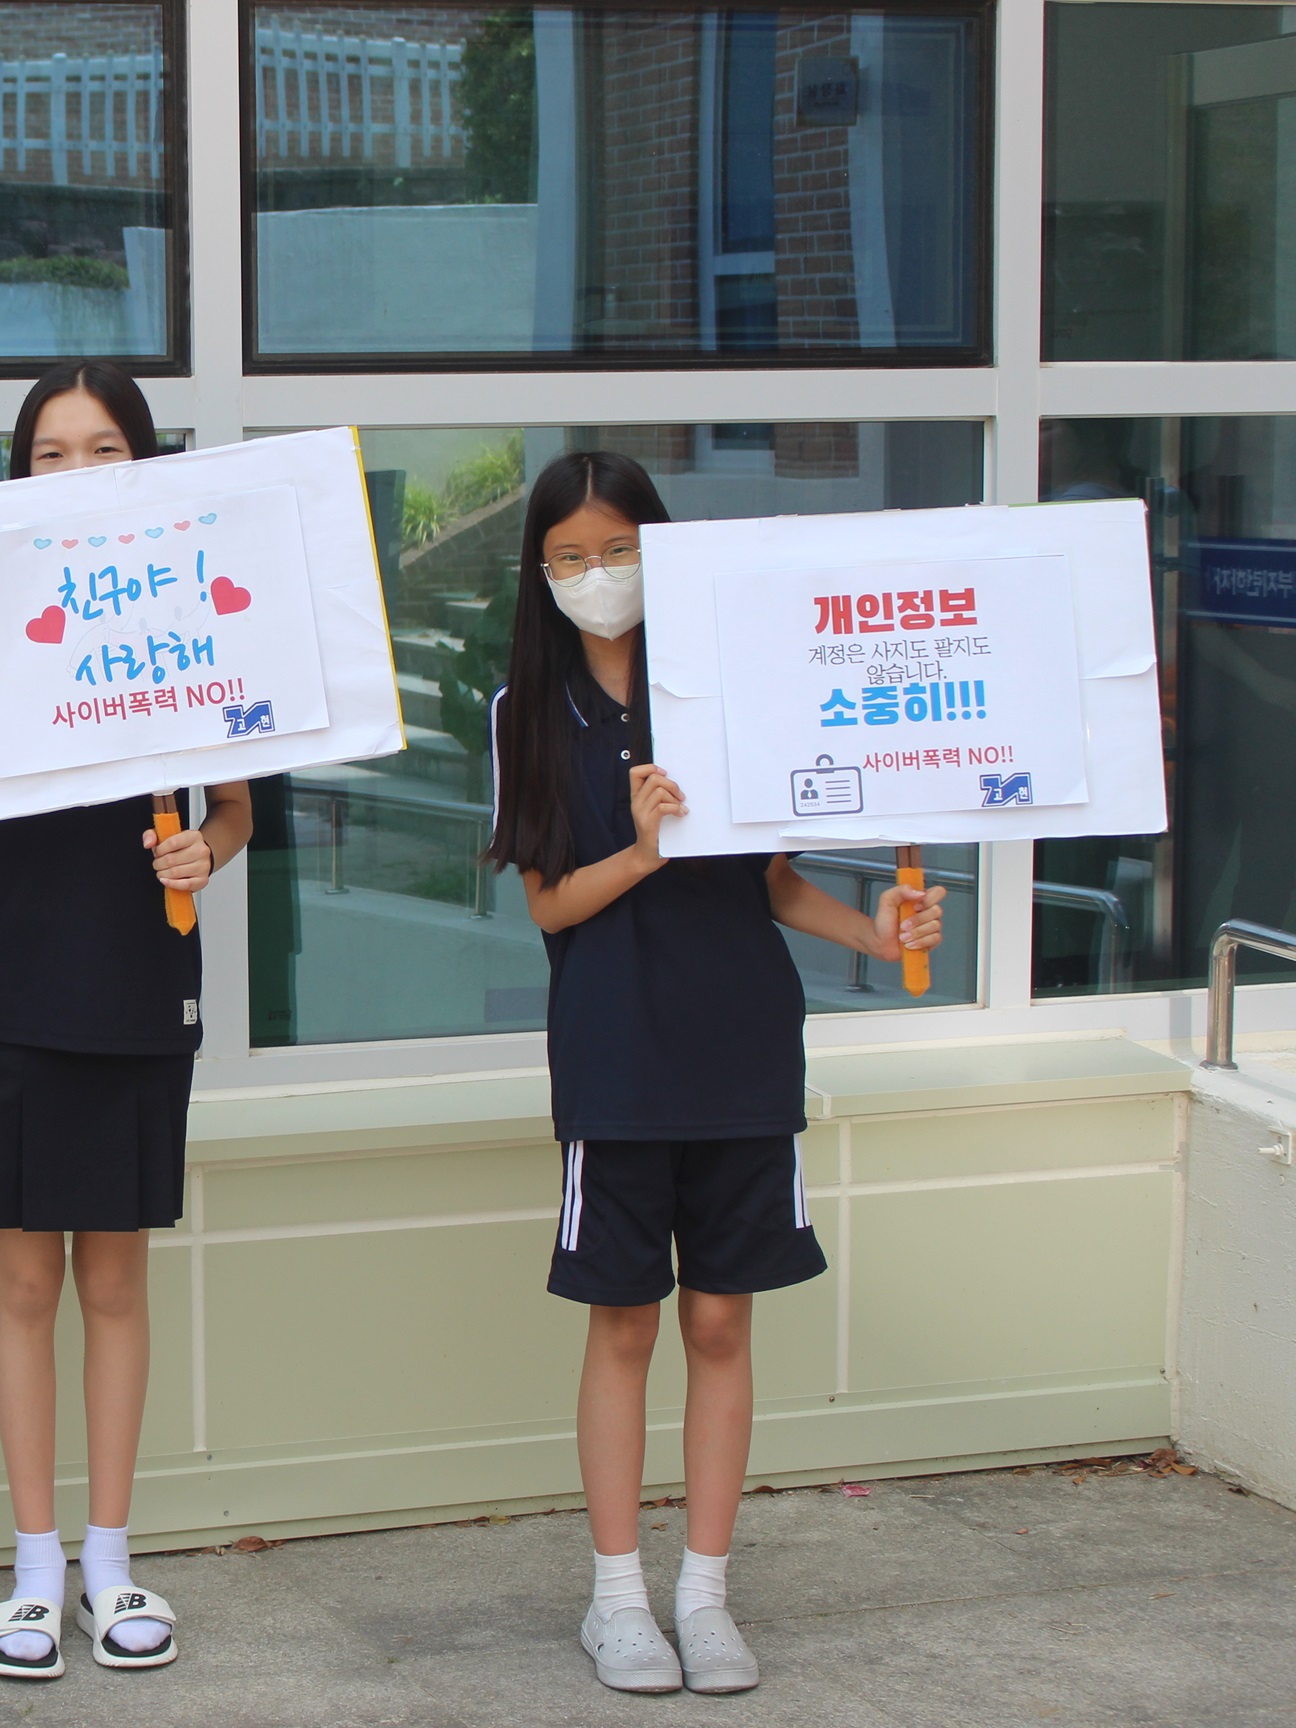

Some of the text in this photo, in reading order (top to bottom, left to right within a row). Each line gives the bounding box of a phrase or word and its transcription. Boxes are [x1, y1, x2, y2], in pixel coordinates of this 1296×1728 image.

[813, 587, 978, 635] 개인정보
[75, 631, 214, 686] 사랑해
[808, 635, 991, 666] 계정은 사지도 팔지도
[866, 660, 947, 685] 않습니다.
[52, 677, 246, 729] 사이버폭력 NO!!
[819, 680, 987, 727] 소중히!!!
[862, 745, 1014, 773] 사이버폭력 NO!!
